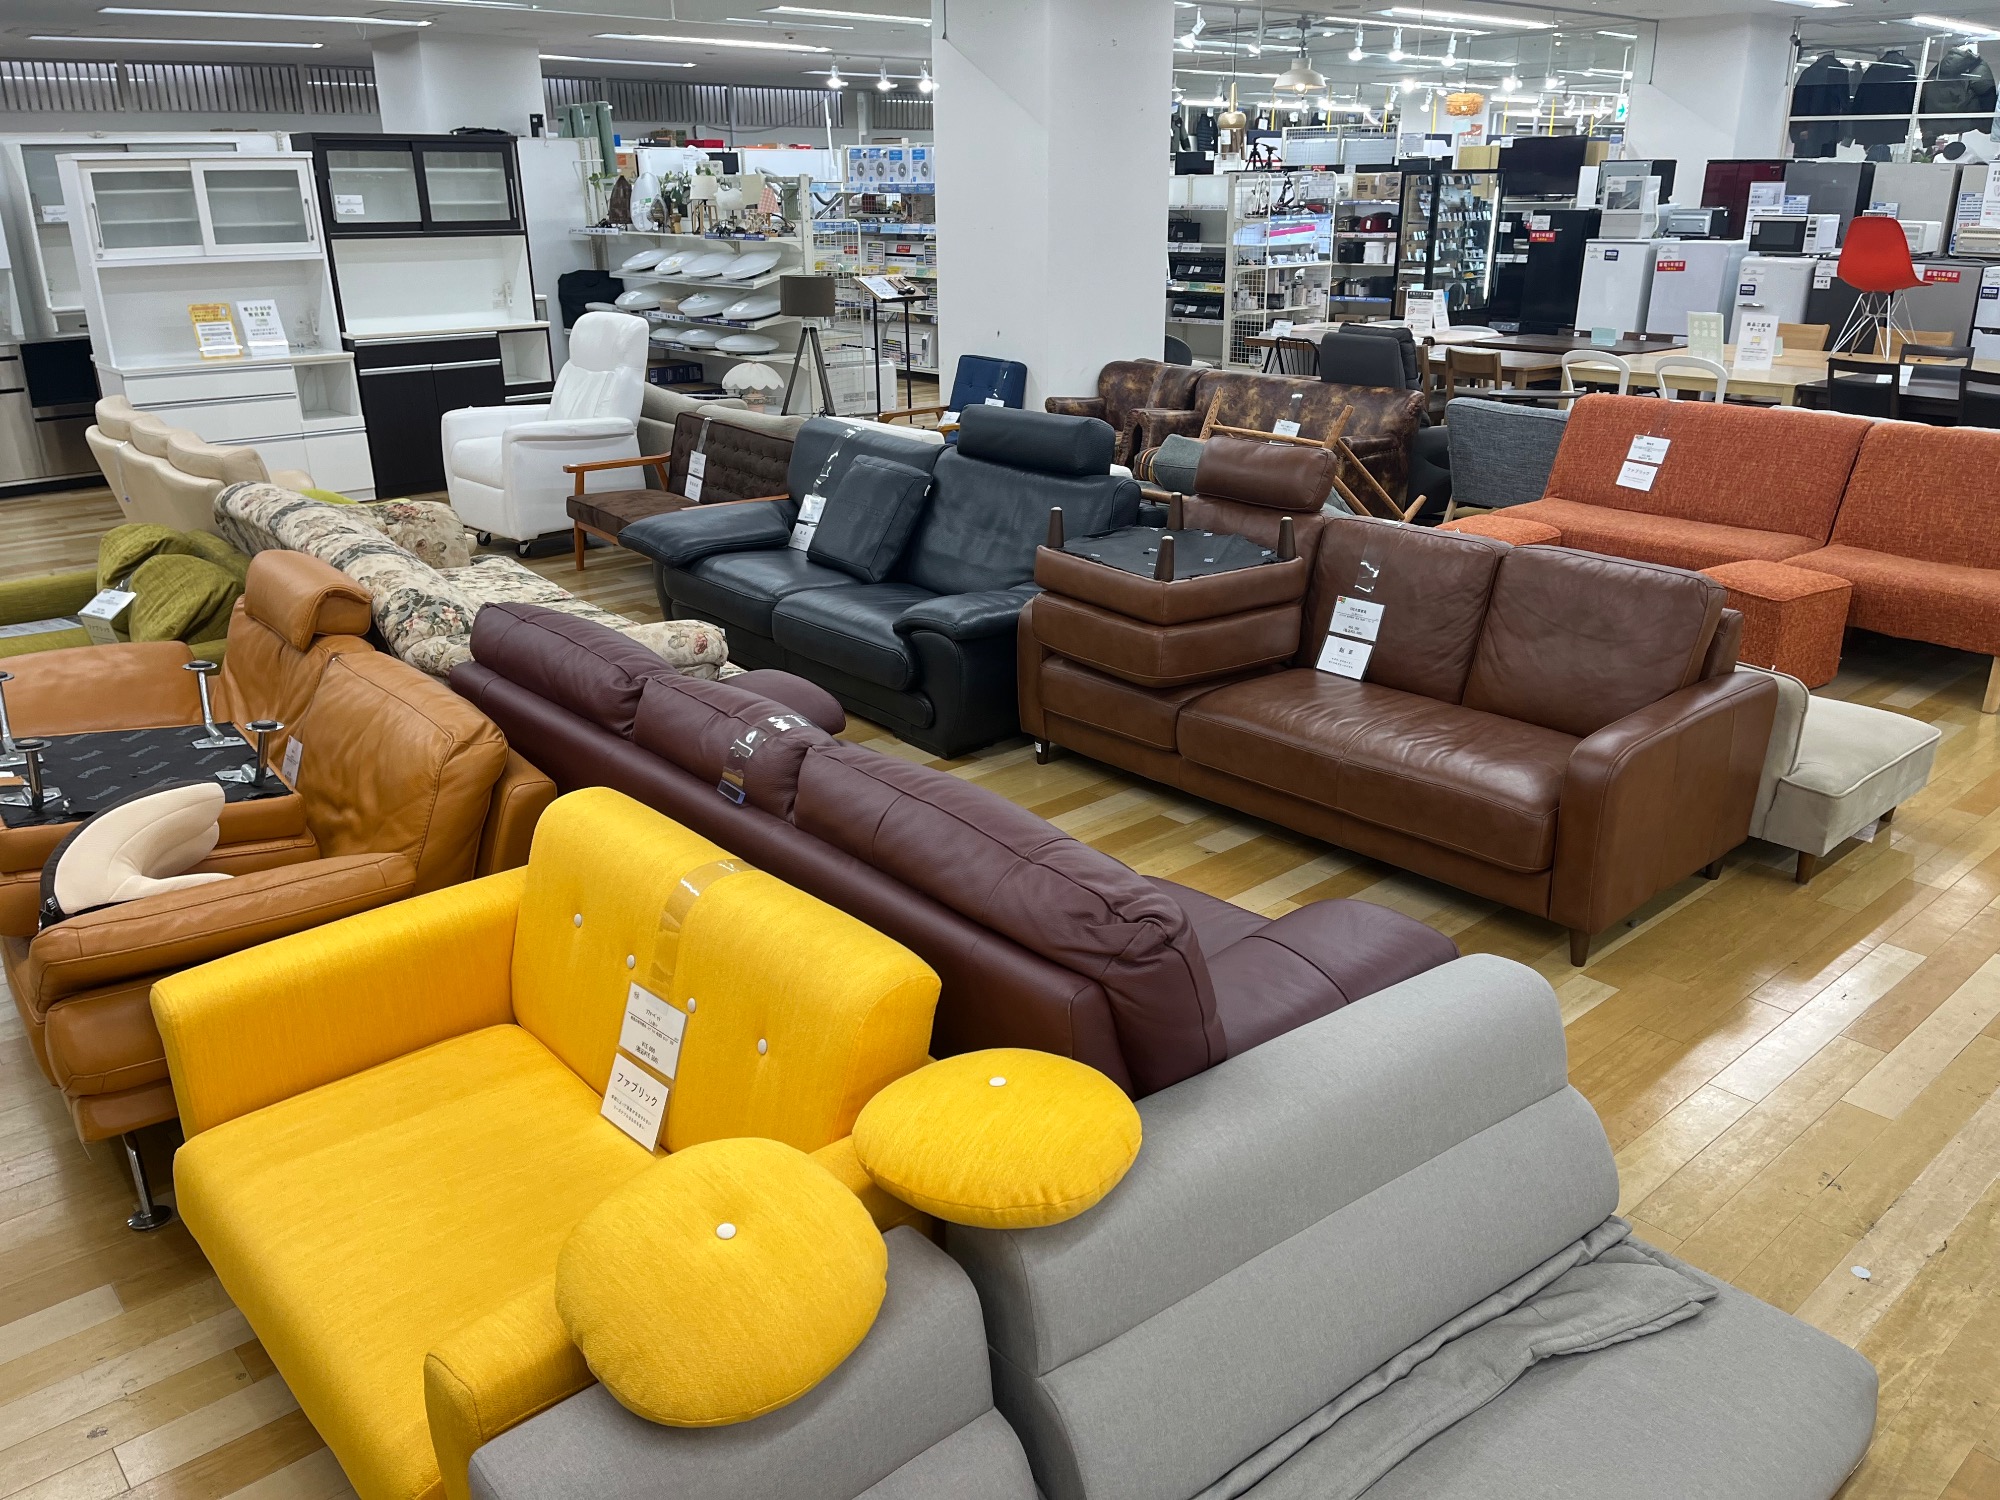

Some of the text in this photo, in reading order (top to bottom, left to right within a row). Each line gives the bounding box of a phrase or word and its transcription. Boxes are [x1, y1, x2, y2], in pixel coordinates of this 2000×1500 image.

[617, 1072, 658, 1107] ファブリック
